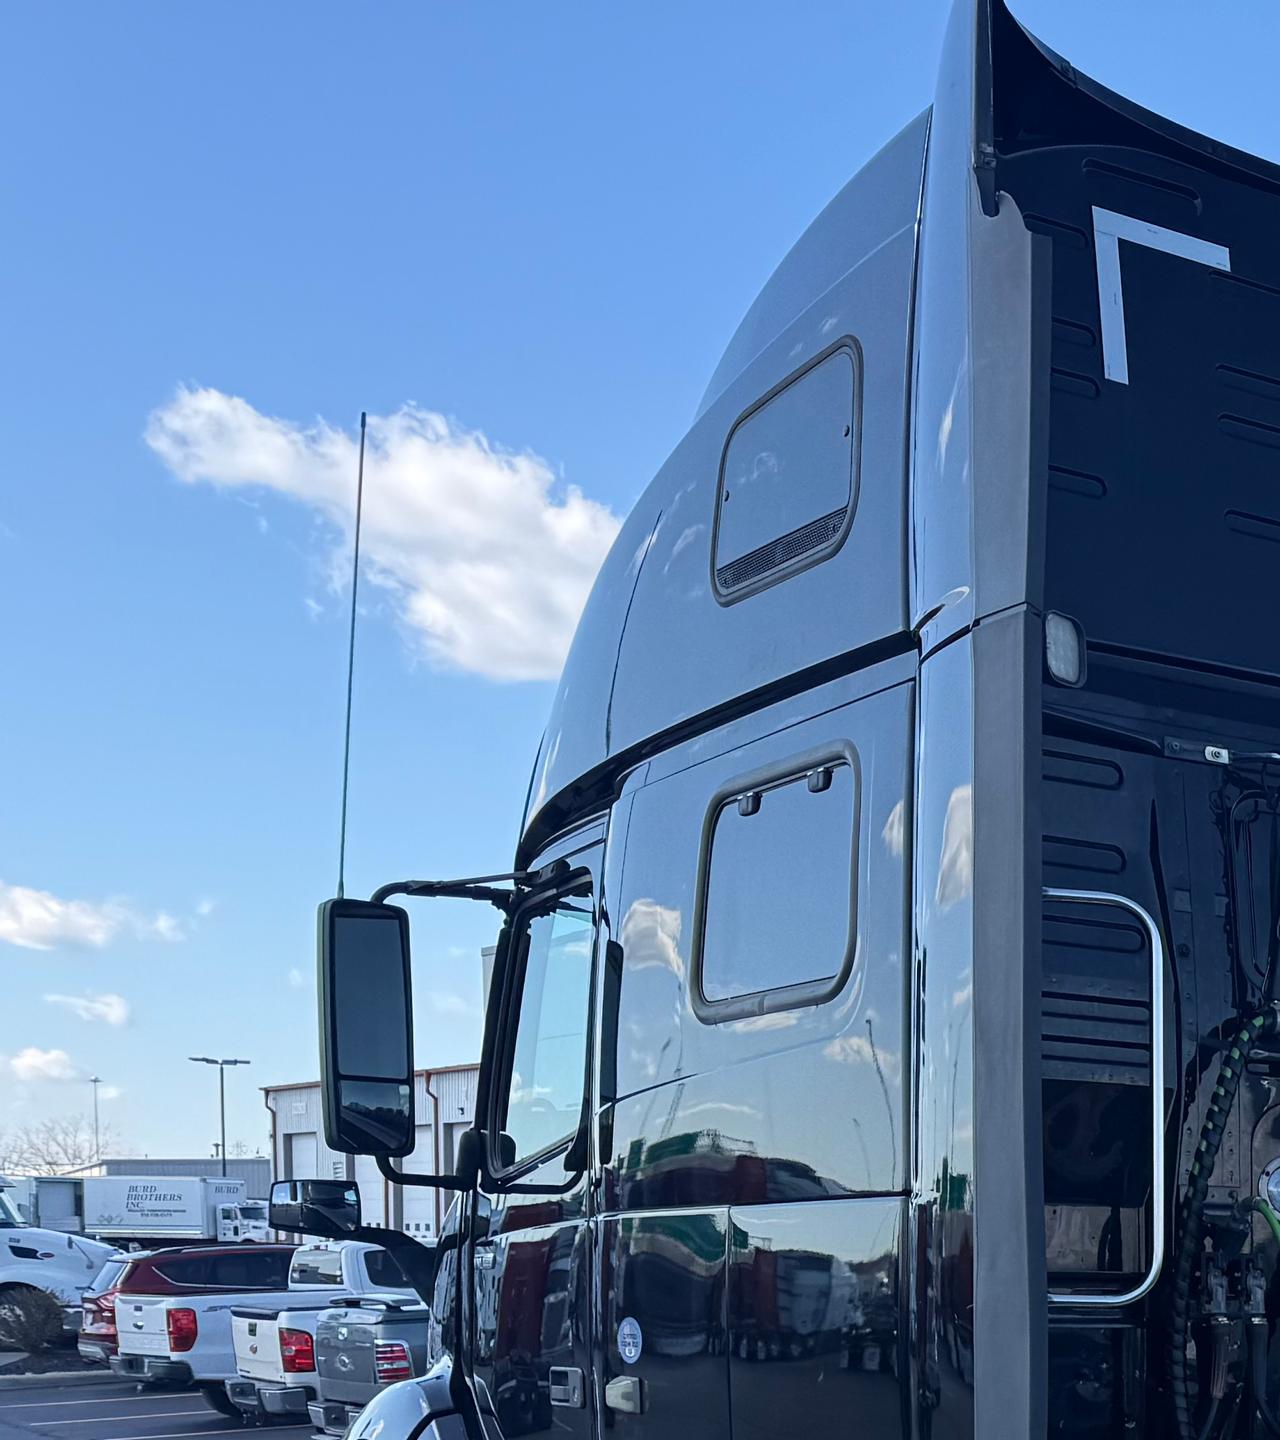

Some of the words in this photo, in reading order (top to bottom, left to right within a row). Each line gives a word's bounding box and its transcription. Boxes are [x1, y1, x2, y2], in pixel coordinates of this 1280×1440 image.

[128, 1185, 157, 1193] BURD
[215, 1185, 239, 1194] BURD
[126, 1193, 183, 1201] BROTHERS
[126, 1201, 145, 1209] INC.
